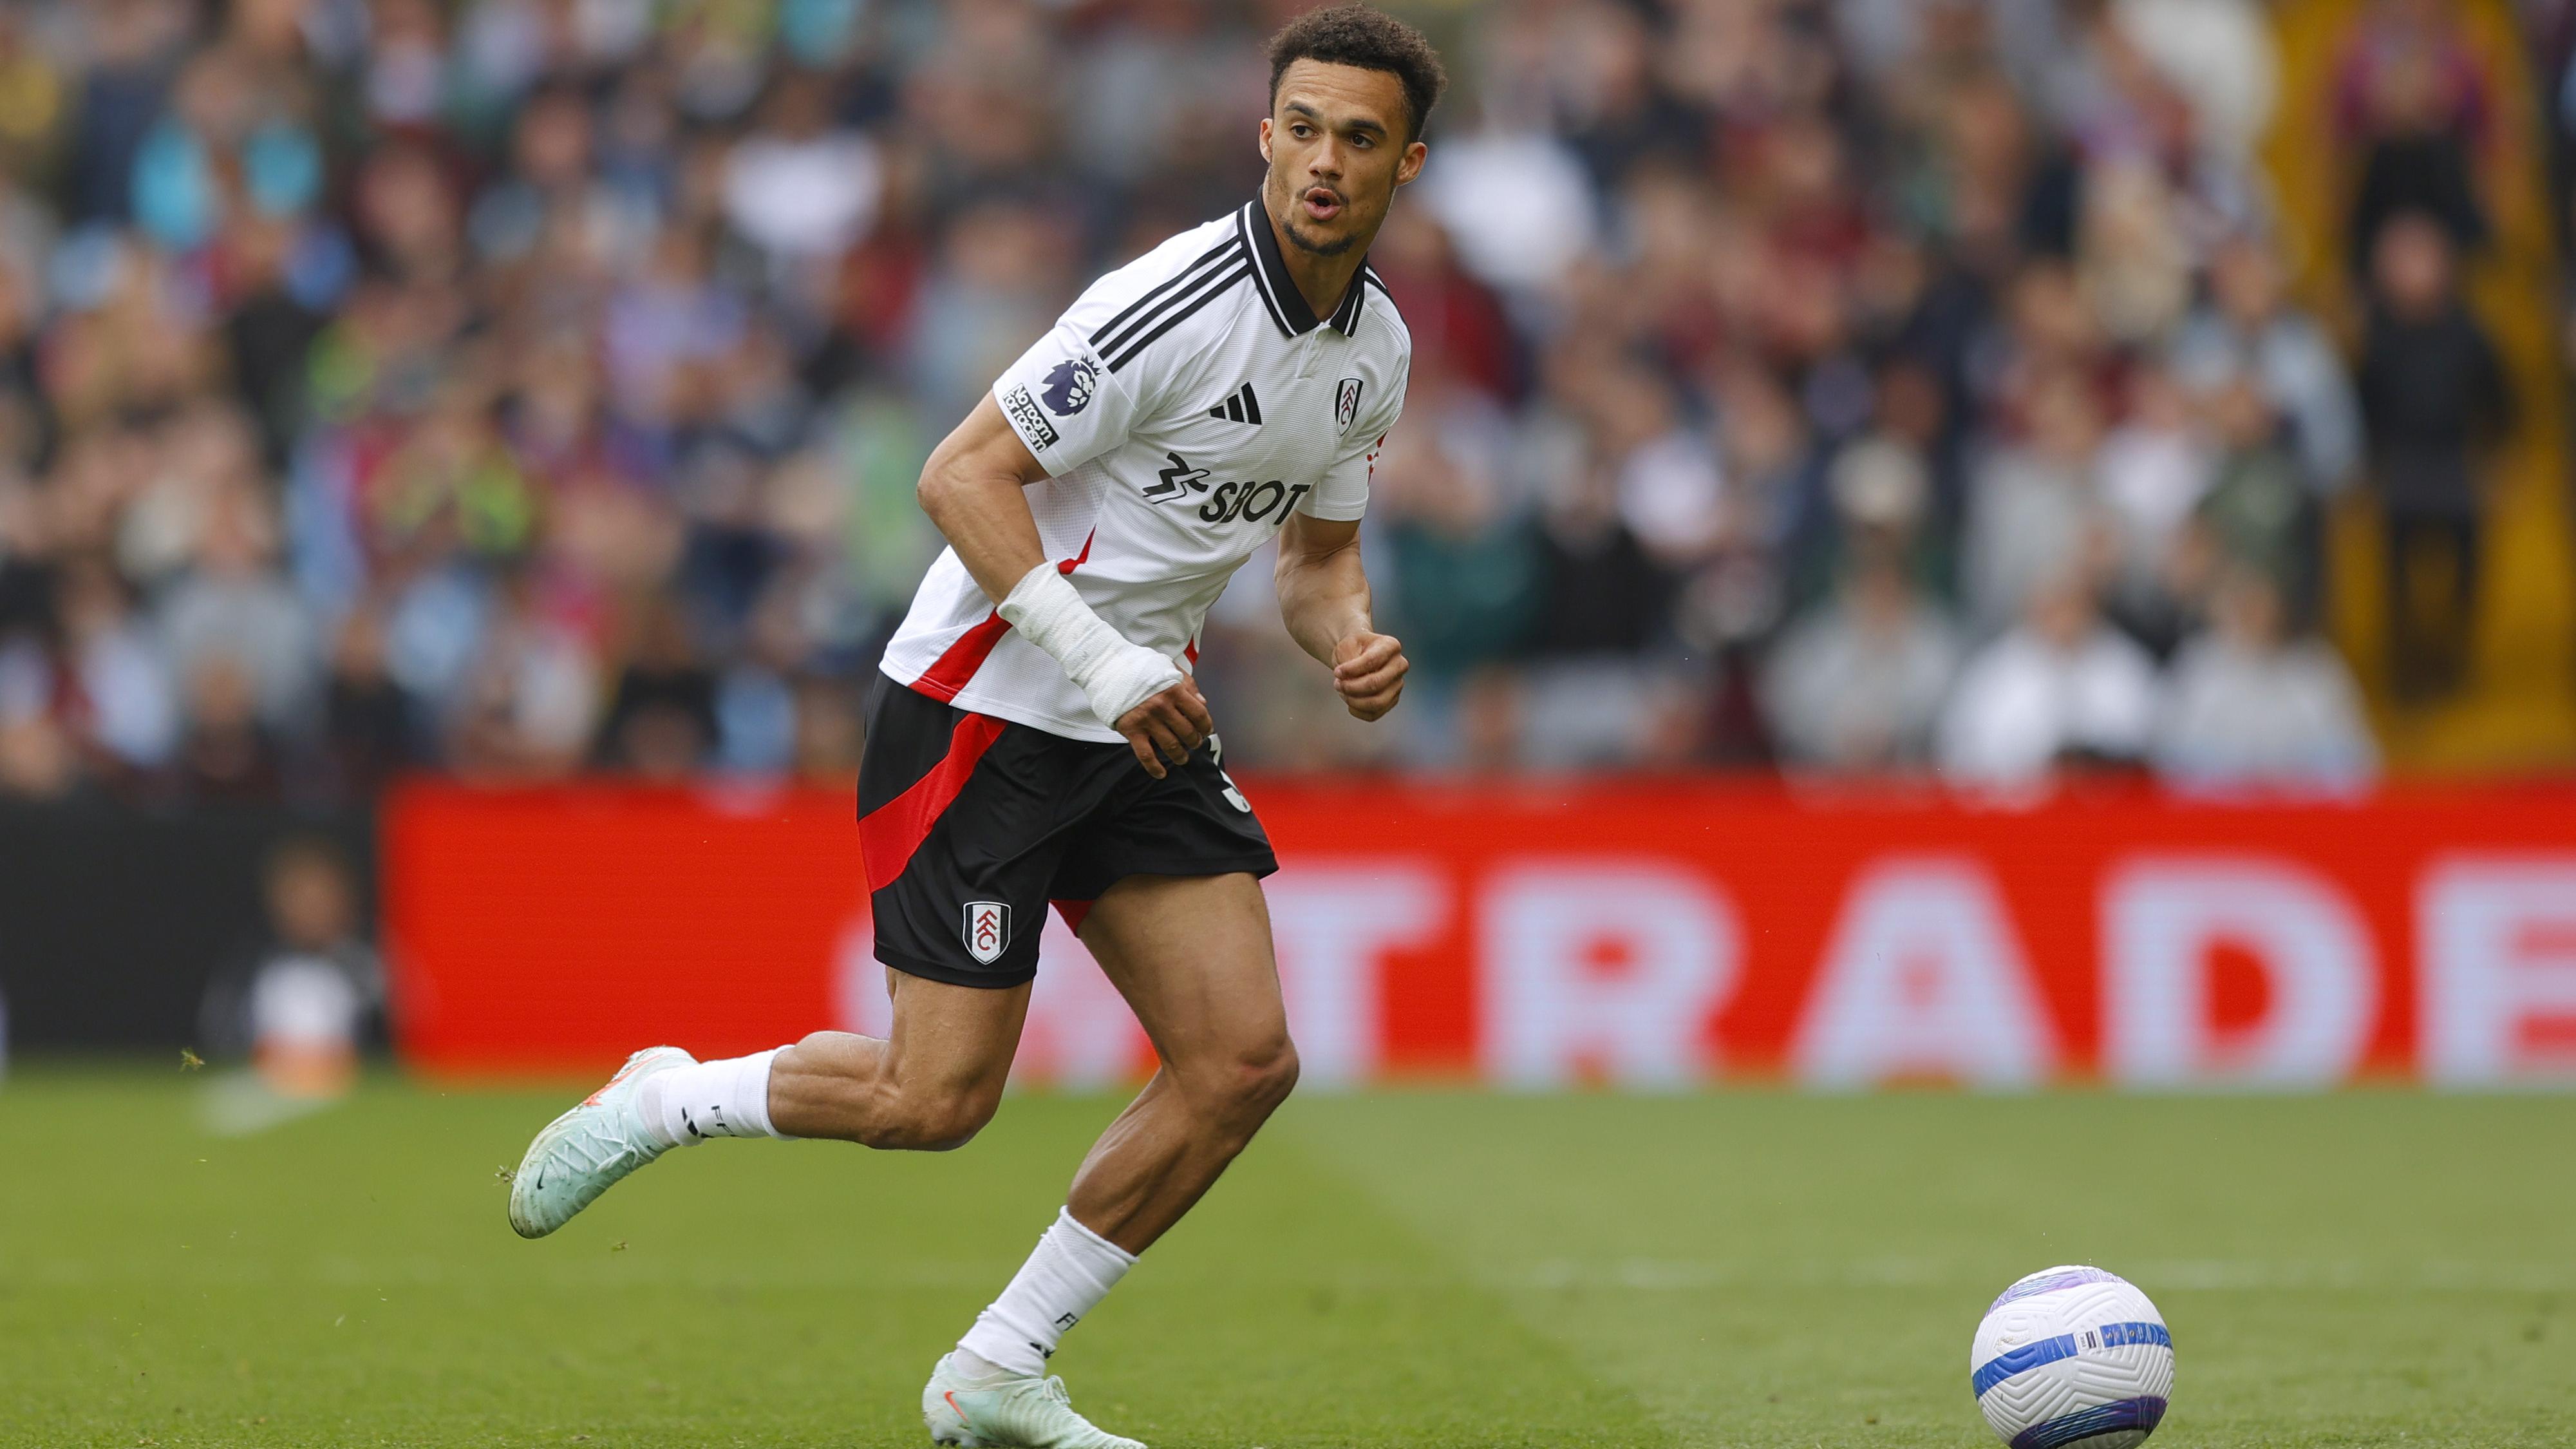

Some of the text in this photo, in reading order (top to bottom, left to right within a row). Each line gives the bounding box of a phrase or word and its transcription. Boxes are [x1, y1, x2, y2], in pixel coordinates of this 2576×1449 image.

[1003, 390, 1047, 452] for racism
[1011, 383, 1053, 440] No room
[1341, 384, 1355, 425] FFC
[1199, 480, 1311, 526] SBOT
[975, 909, 998, 951] FFC
[1262, 860, 2576, 1088] TRADE
